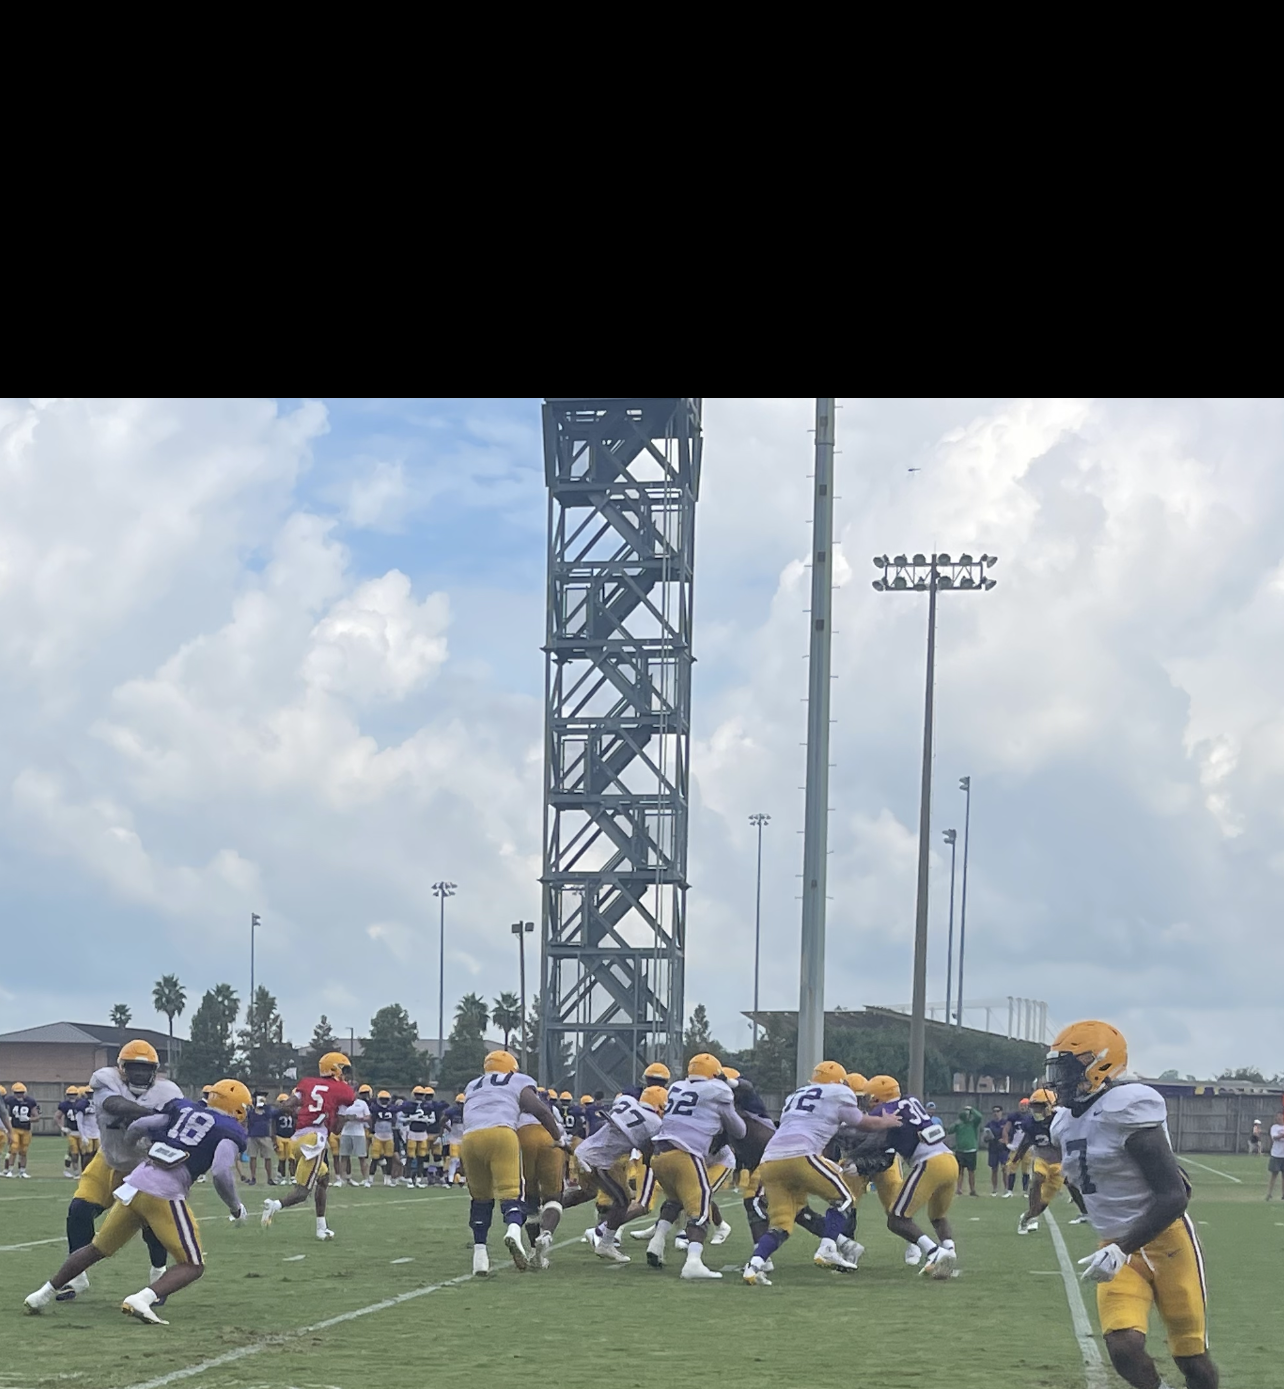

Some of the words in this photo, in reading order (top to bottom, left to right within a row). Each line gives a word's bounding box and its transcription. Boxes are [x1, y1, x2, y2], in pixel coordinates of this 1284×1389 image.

[308, 1085, 329, 1112] 5
[664, 1086, 698, 1116] 52
[898, 1097, 930, 1126] 30
[167, 1106, 216, 1146] 18
[279, 1116, 293, 1129] 31
[609, 1101, 647, 1128] 27
